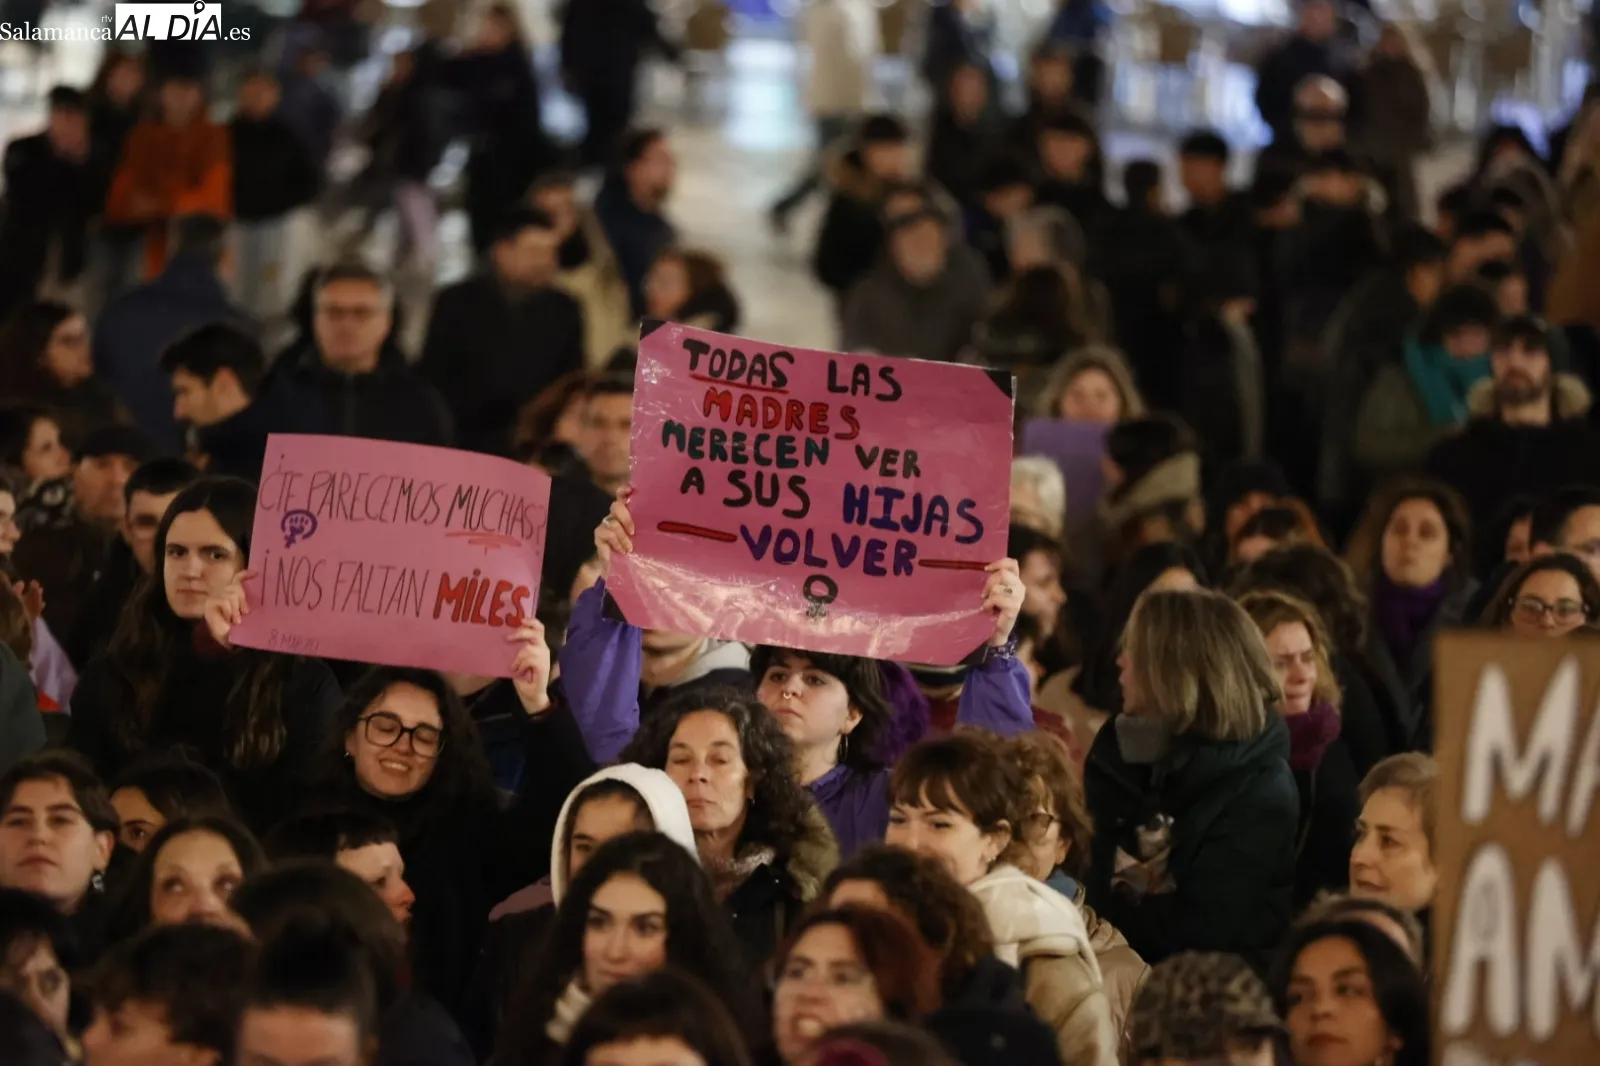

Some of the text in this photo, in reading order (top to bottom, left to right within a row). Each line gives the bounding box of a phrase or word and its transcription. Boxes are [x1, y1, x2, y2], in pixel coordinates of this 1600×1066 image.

[682, 338, 902, 402] TODAS LAS
[702, 386, 860, 440] MADRES
[661, 420, 921, 479] MERECEN VER
[306, 470, 448, 526] PARECEMOS
[680, 466, 984, 545] A SUS HIJAS
[739, 524, 918, 577] VOLVER
[331, 561, 429, 618] FALTAN
